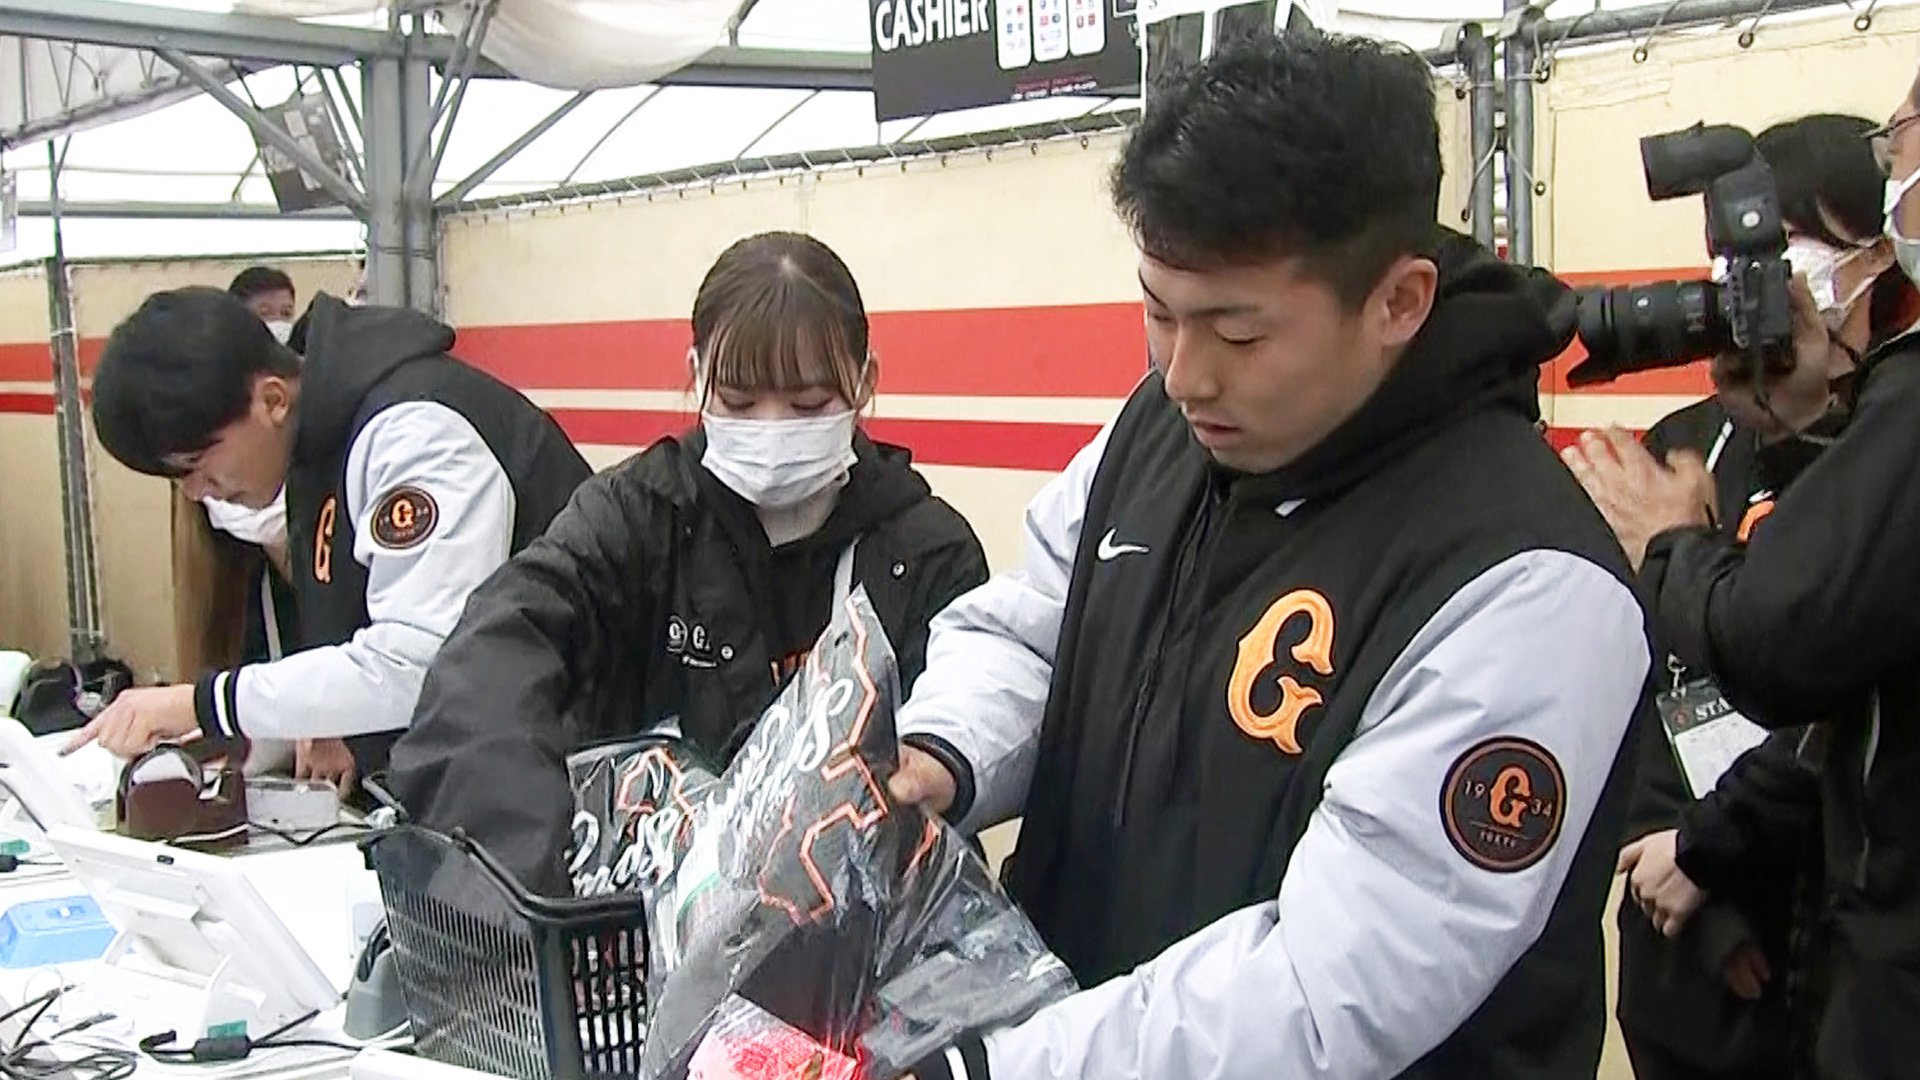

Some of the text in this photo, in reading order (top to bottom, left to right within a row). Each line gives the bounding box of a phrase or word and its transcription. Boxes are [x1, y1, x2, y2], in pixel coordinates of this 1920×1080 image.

[874, 0, 990, 52] CASHIER
[1227, 590, 1335, 755] G
[1694, 697, 1731, 721] STA
[1464, 765, 1552, 829] 19 G 34
